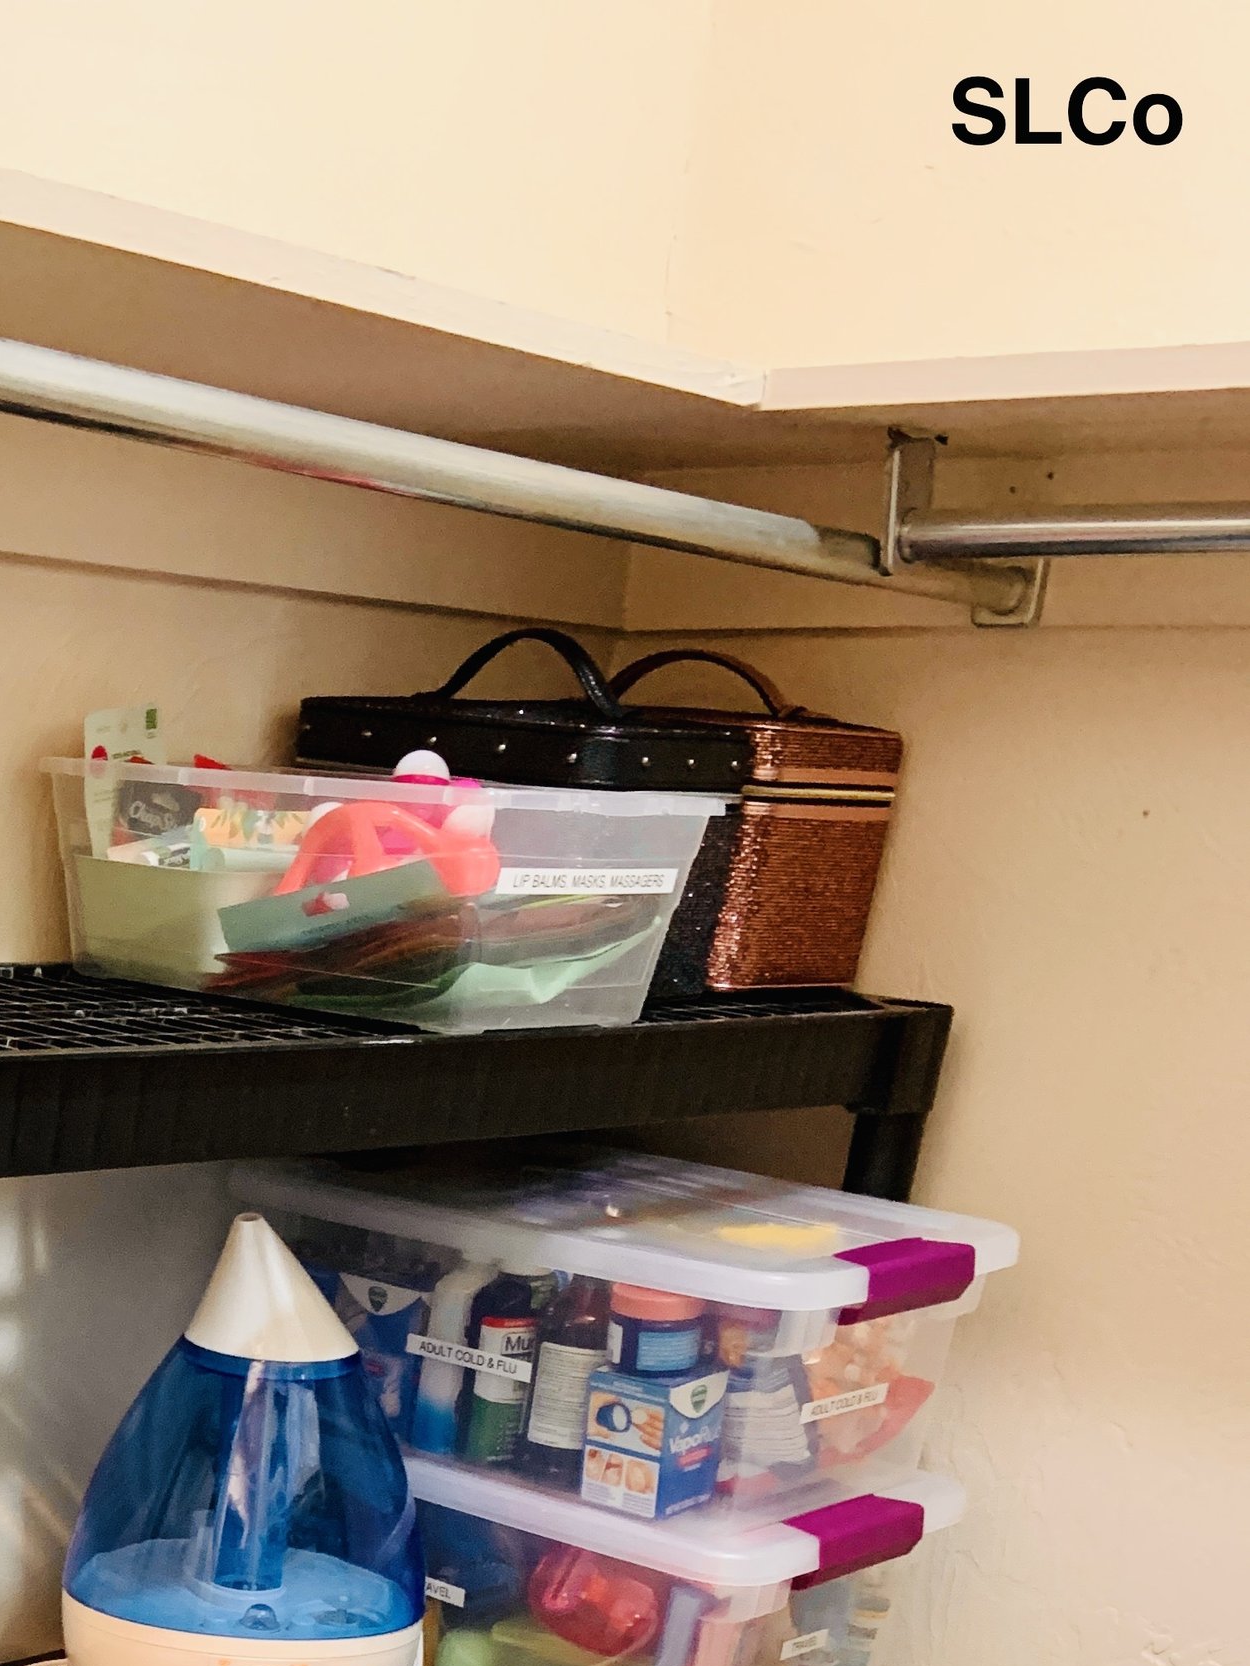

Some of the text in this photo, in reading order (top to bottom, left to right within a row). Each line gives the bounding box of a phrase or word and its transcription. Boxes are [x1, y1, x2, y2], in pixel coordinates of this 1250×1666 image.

[513, 874, 529, 888] LIP
[610, 873, 665, 888] MASSAGERS
[419, 1340, 452, 1358] ADULT
[454, 1349, 485, 1367] COLD
[487, 1356, 494, 1369] &
[496, 1360, 518, 1374] FLU
